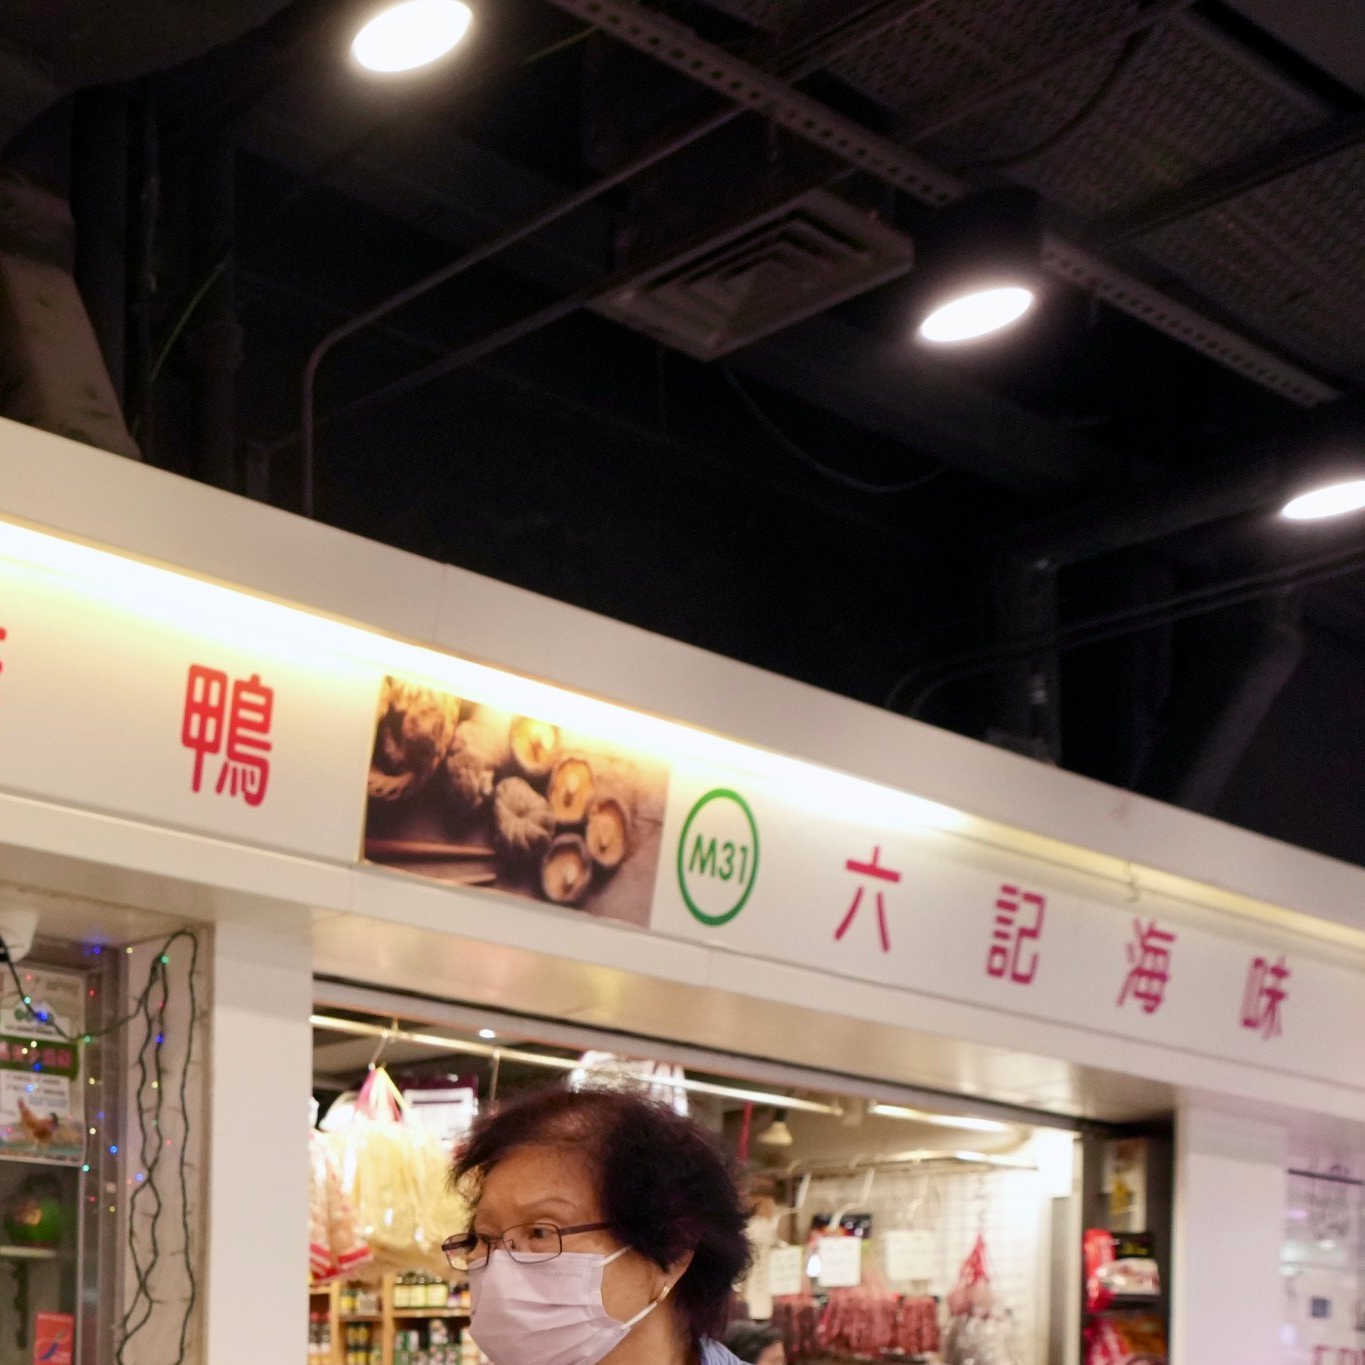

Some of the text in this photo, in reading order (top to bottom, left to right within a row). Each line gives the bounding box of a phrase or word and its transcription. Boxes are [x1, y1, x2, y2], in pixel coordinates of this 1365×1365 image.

[687, 835, 750, 887] M31
[832, 845, 1293, 1041] 六記海味
